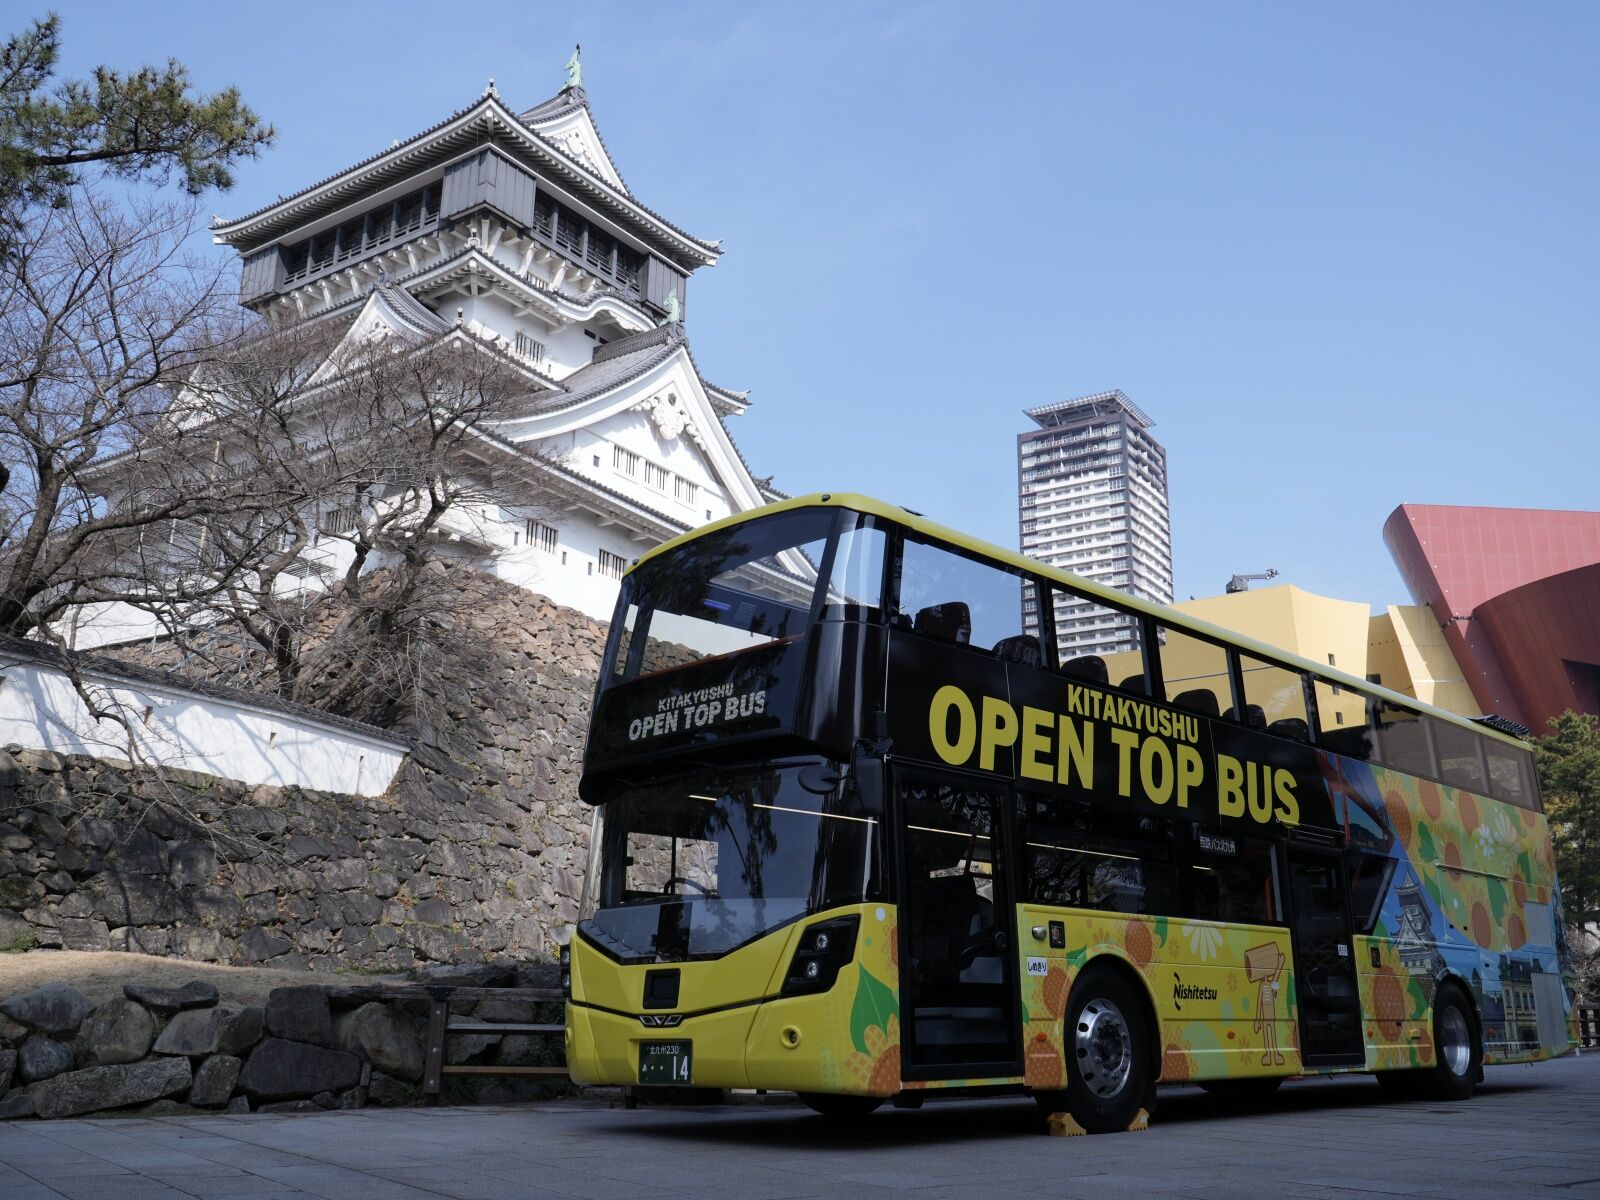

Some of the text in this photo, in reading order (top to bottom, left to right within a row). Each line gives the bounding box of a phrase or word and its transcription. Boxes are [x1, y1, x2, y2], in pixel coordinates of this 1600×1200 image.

[628, 691, 766, 740] OPEN TOP BUS
[658, 683, 734, 711] KITAKYUSHU
[1068, 683, 1198, 744] KITAKYUSHU
[929, 685, 1300, 829] OPEN TOP BUS
[1027, 961, 1047, 972] しめきり
[1173, 984, 1217, 1000] Nishitetsu
